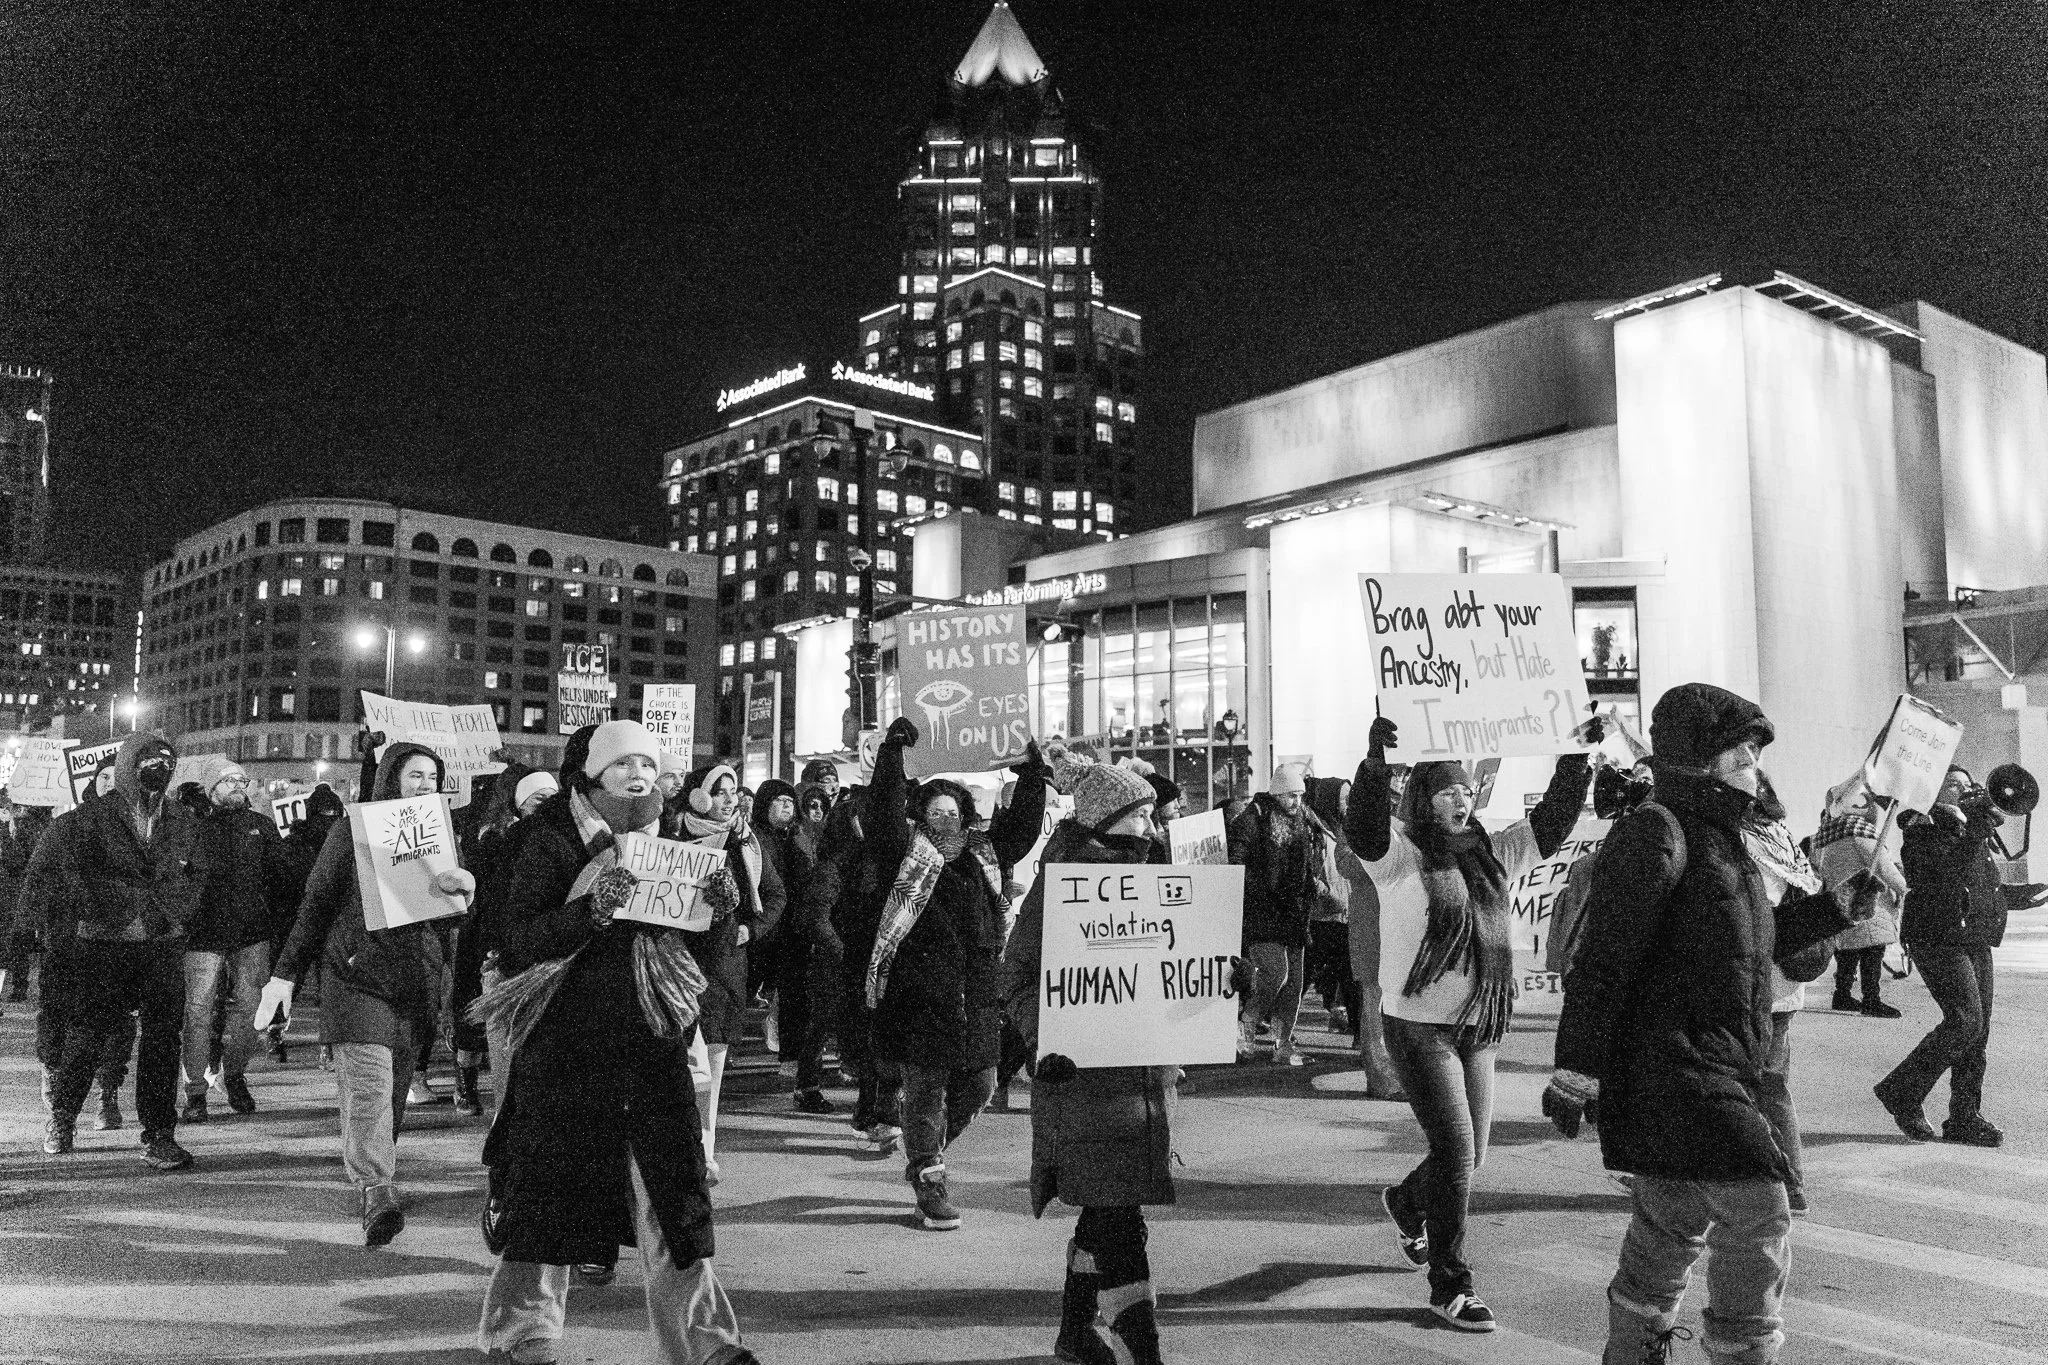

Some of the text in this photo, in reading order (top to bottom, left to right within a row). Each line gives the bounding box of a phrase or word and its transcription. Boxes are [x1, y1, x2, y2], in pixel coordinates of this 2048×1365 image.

[727, 363, 806, 406] Associated Bank
[845, 366, 934, 401] Associated Bank
[1004, 578, 1074, 605] Performing
[1074, 573, 1106, 595] Arts
[908, 613, 1014, 645] HISTORY
[1365, 577, 1542, 660] Brag abt your
[562, 643, 605, 674] ICE
[925, 641, 1021, 671] HAS ITS
[1470, 639, 1507, 680] but
[1510, 635, 1555, 681] Hate
[583, 688, 610, 705] UNDER
[649, 699, 689, 709] CHOICE IS
[656, 687, 684, 698] IF THE
[978, 692, 1028, 718] EYES
[367, 700, 497, 734] WE THE PEOPLE
[646, 709, 692, 722] OBEY OR
[674, 723, 691, 734] YOU
[675, 737, 692, 746] LIVE
[958, 719, 1027, 758] ON US
[1900, 718, 1946, 751] Come Join
[72, 747, 118, 771] ABOLIS
[1897, 744, 1932, 773] the Line
[399, 805, 415, 817] WE
[399, 813, 420, 829] ARE
[394, 823, 437, 854] ALL
[390, 844, 441, 867] IMMIGRANTS
[631, 839, 725, 881] HUMANITY
[628, 879, 707, 921] FIRST
[1060, 874, 1139, 904] ICE
[1079, 911, 1175, 951] violating
[1045, 955, 1240, 1009] HUMAN RIGHTS
